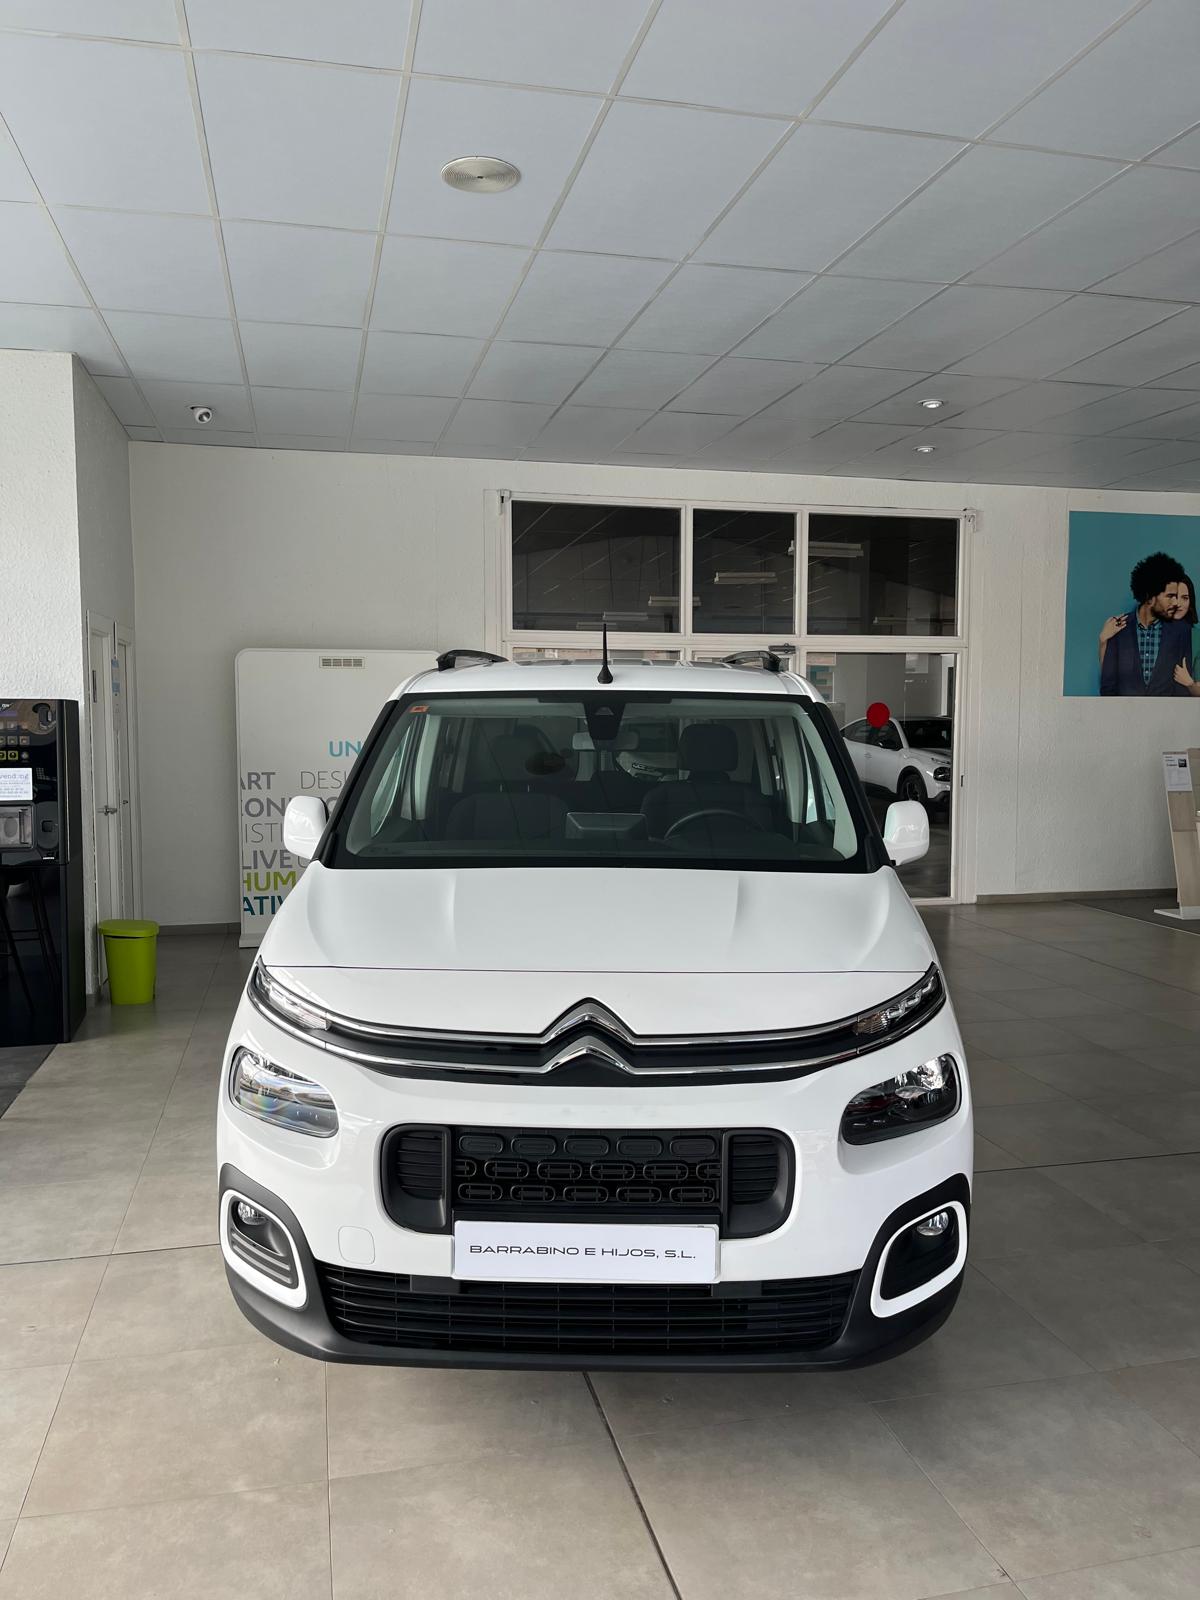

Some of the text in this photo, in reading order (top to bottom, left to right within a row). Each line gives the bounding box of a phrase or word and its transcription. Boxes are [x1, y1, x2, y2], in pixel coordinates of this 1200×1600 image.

[470, 1245, 696, 1259] BARRABINO E HIJOS, S.L.
